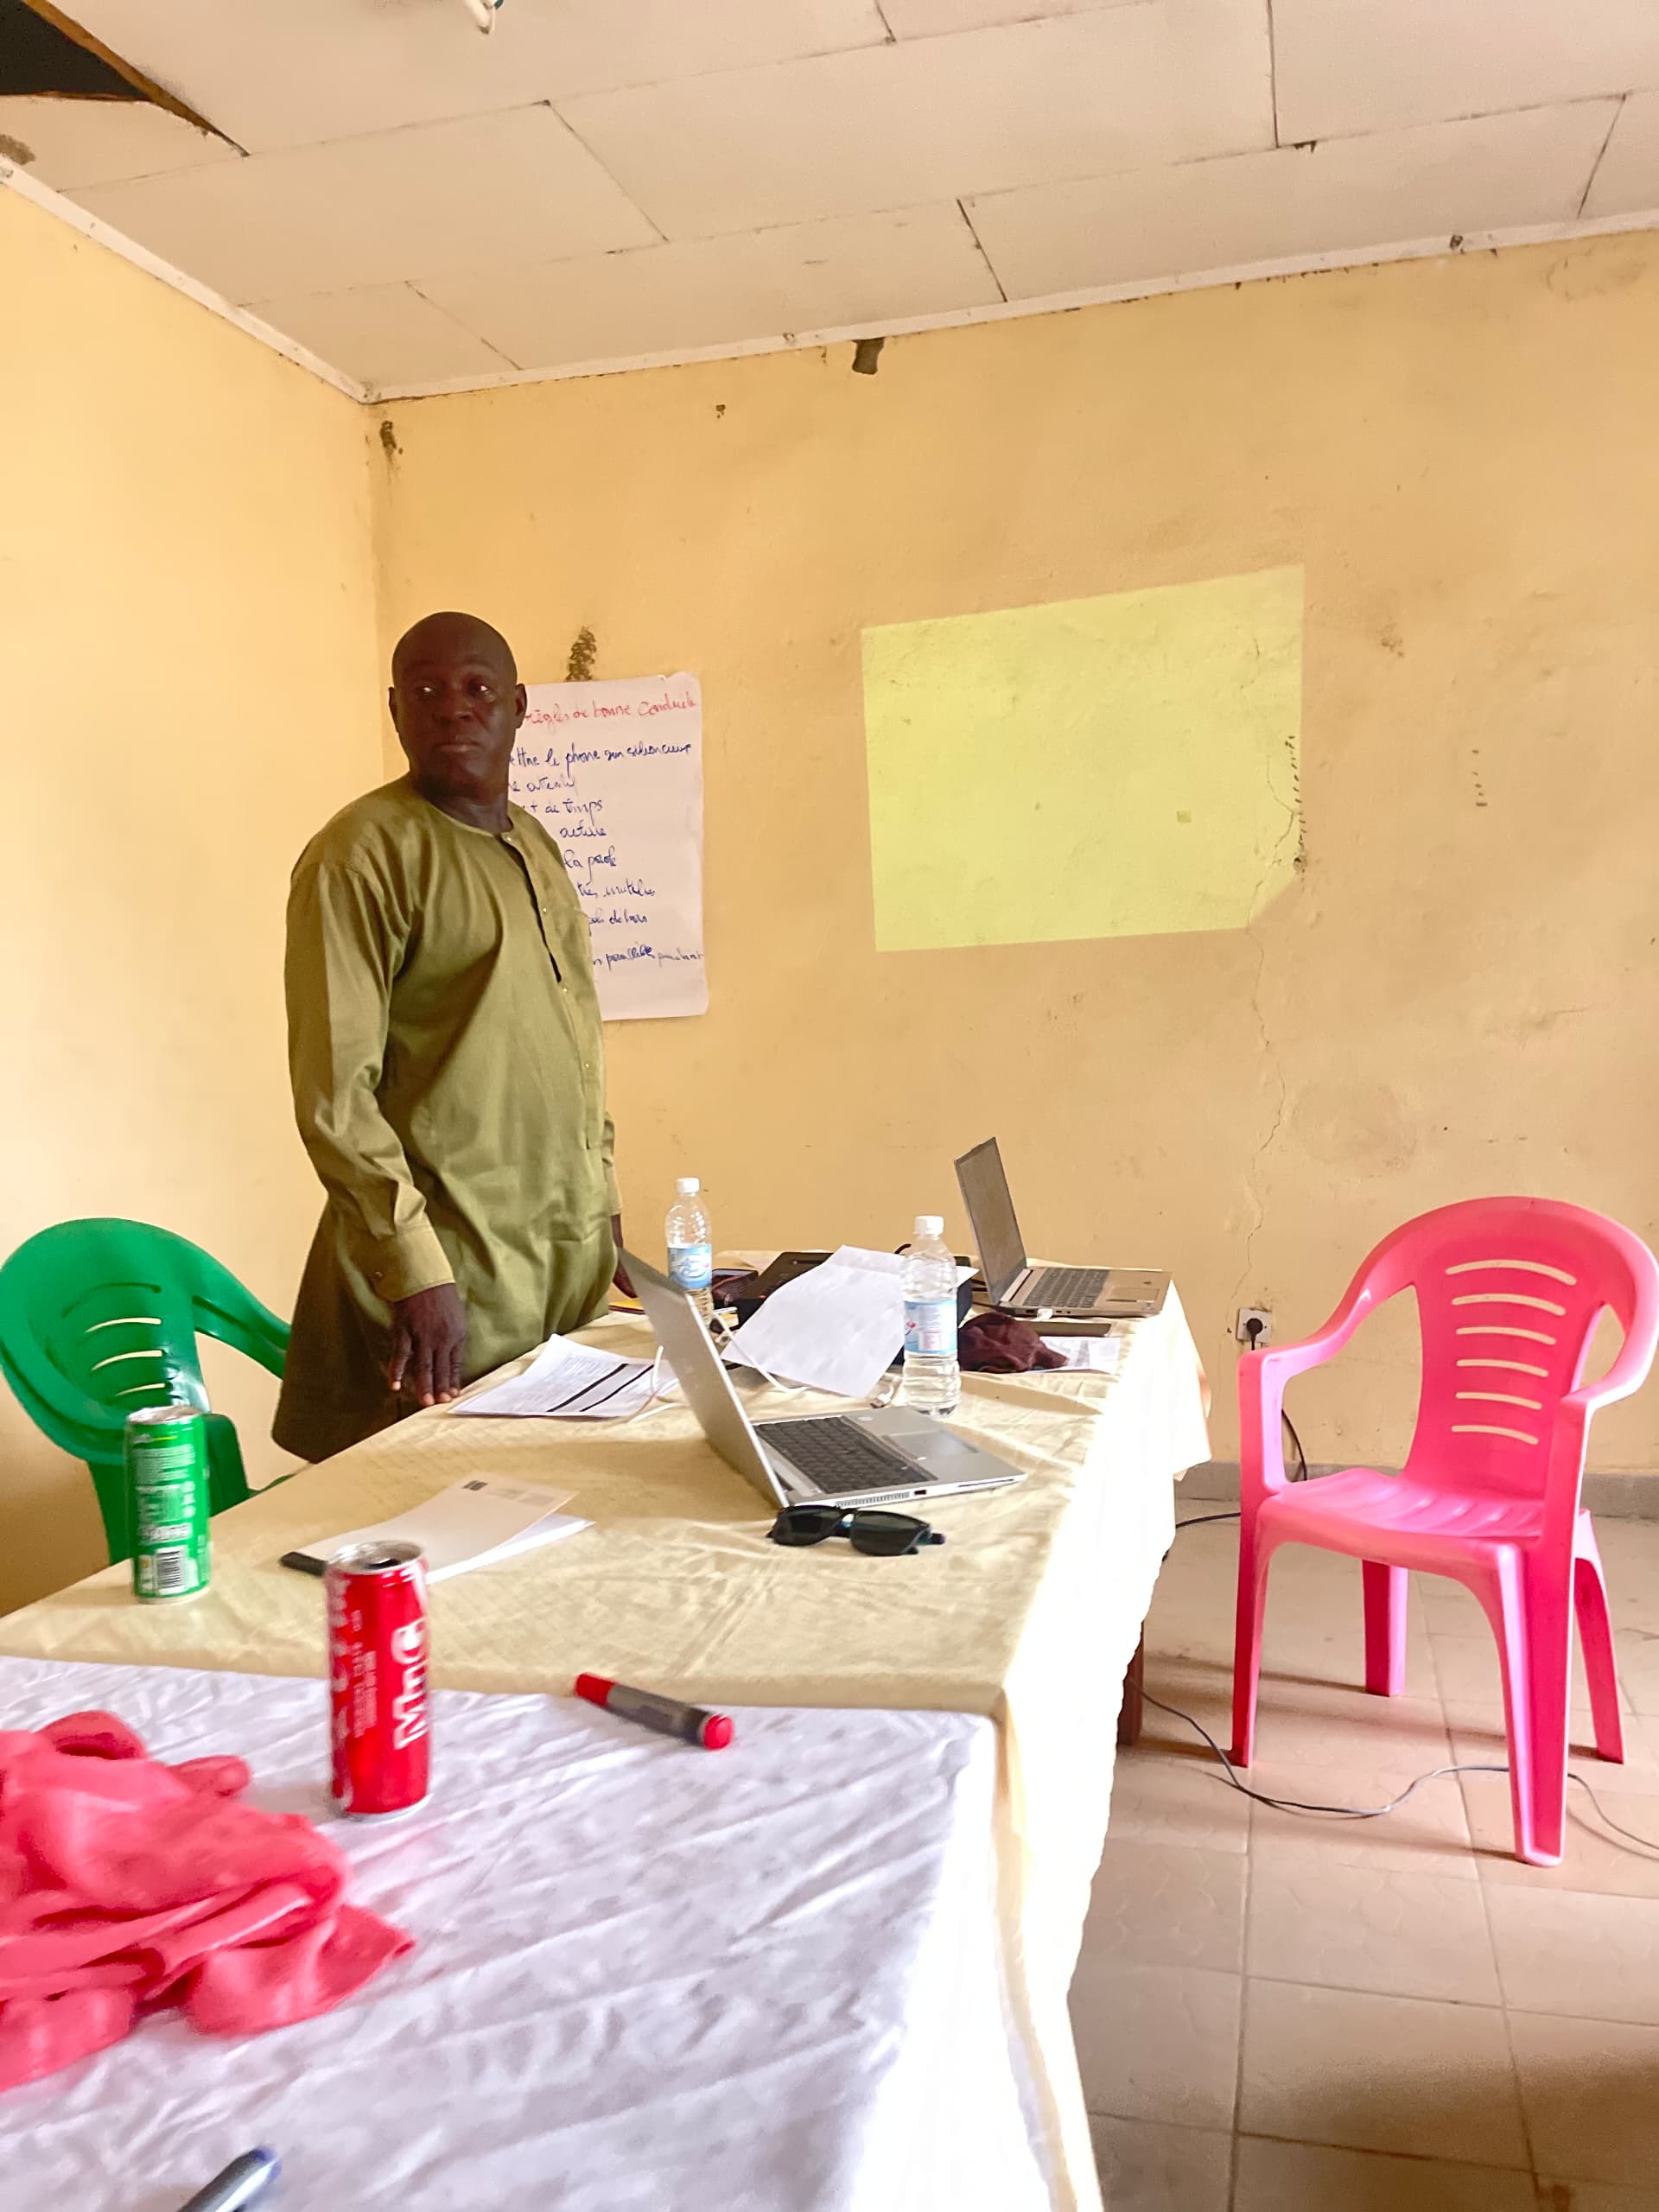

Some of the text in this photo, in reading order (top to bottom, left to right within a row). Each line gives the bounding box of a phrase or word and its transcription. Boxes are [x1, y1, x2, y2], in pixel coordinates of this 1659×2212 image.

[510, 747, 540, 767] ettre
[545, 747, 561, 766] le
[565, 742, 601, 779] phone
